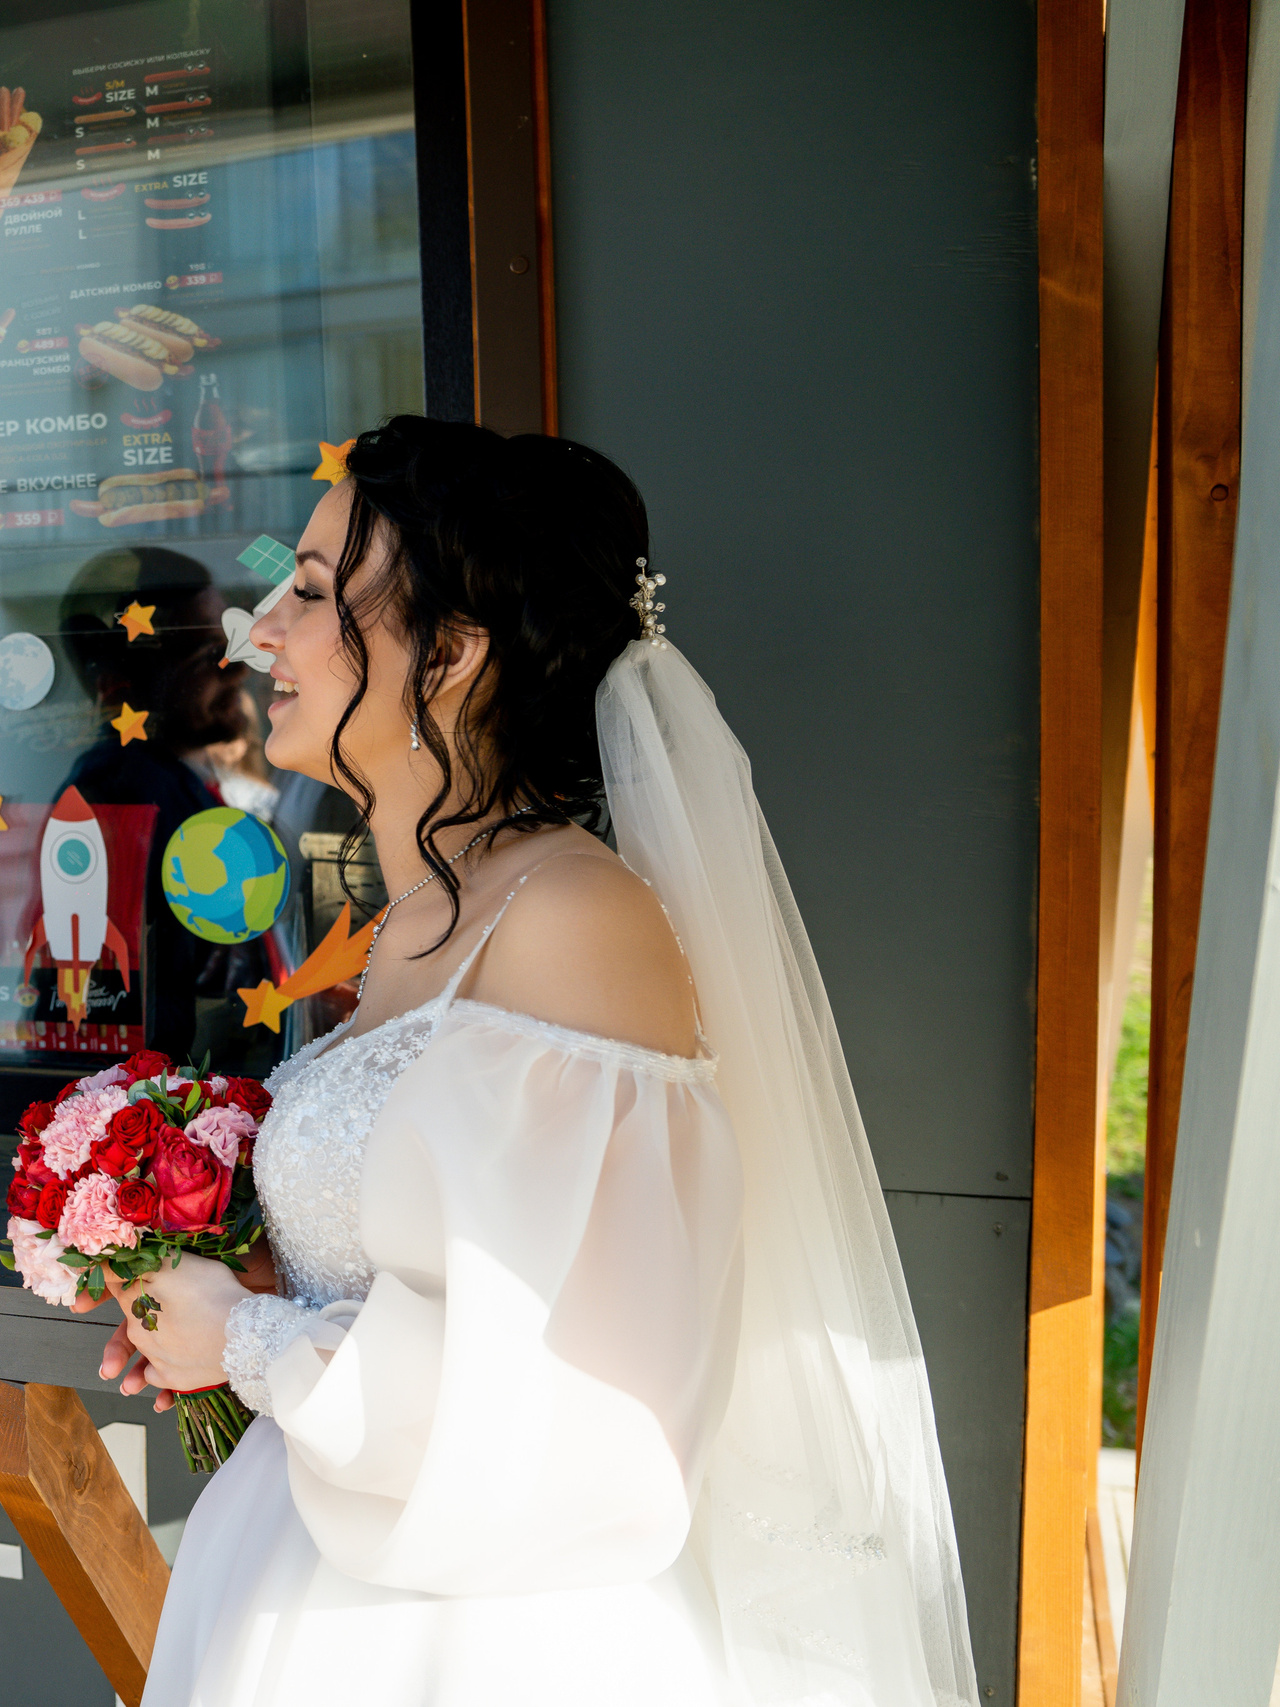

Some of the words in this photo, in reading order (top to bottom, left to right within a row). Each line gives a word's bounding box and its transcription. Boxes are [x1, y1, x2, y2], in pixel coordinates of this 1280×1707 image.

[73, 65, 106, 75] ВЫБЕРИ
[108, 59, 145, 70] СОСИСКУ
[147, 55, 165, 63] ИЛИ
[167, 48, 211, 60] КОЛБАСКУ
[105, 80, 125, 90] S/M
[146, 85, 159, 97] M
[106, 89, 136, 103] SIZE
[146, 117, 159, 129] M
[75, 127, 84, 138] S
[148, 149, 160, 160] M
[76, 159, 85, 170] S
[135, 182, 169, 193] EXTRA
[173, 172, 208, 188] SIZE
[0, 198, 21, 208] 369
[24, 194, 45, 204] 439
[4, 208, 62, 225] ДВОЙНОЙ
[77, 210, 86, 220] L
[5, 224, 42, 237] РУЛЛЕ
[78, 229, 87, 239] L
[186, 275, 206, 286] 339
[70, 284, 120, 300] ДАТСКИЙ
[123, 280, 162, 293] КОМБО
[34, 339, 54, 349] 489
[33, 365, 71, 376] КОМБО
[26, 412, 108, 436] КОМБО
[122, 432, 172, 447] EXTRA
[123, 447, 173, 466] SIZE
[17, 473, 97, 492] ВКУСНЕЕ
[14, 513, 41, 525] 359
